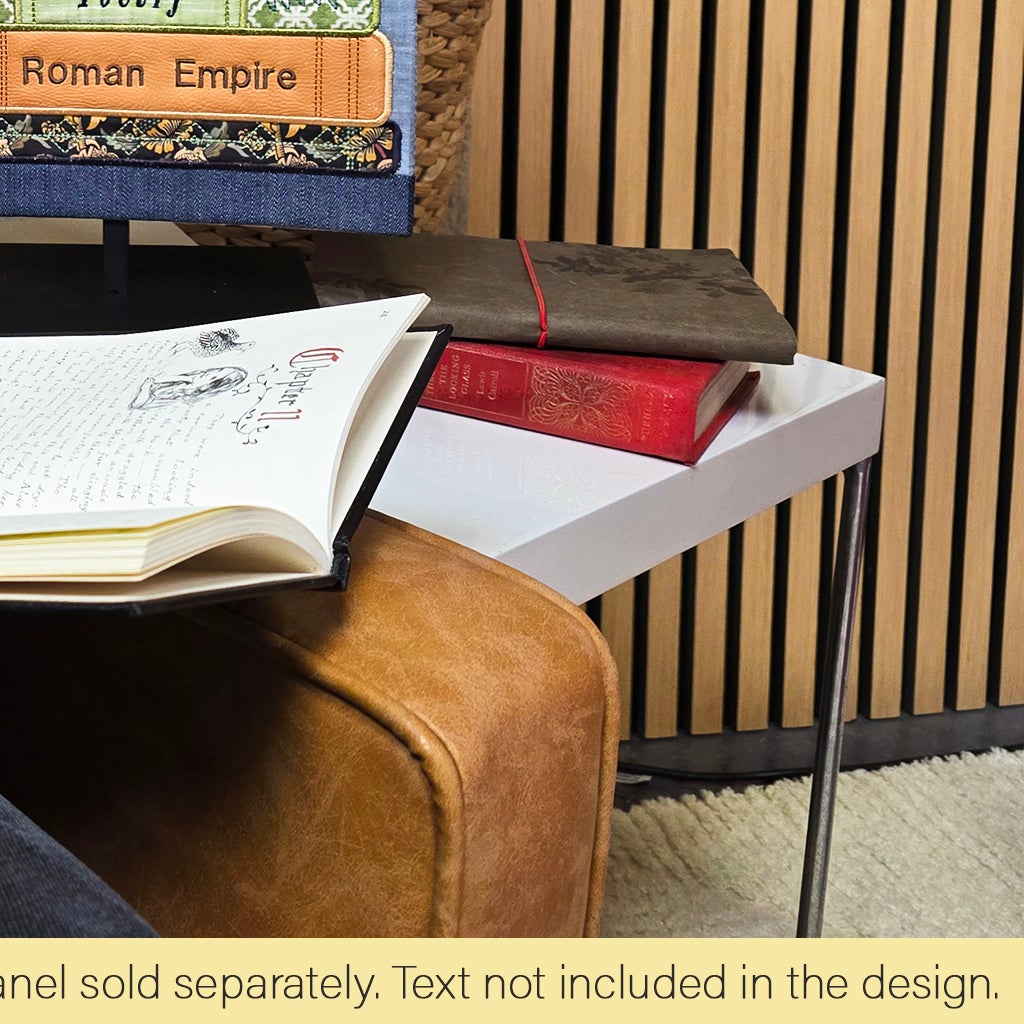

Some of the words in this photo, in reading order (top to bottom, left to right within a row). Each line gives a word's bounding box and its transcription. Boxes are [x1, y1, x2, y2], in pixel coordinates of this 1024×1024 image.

[22, 56, 145, 87] Roman
[175, 58, 297, 94] Empire
[274, 347, 344, 406] Chapter
[53, 475, 70, 494] The
[78, 472, 96, 511] clinging
[99, 460, 115, 503] animals
[116, 453, 134, 498] draggled
[147, 452, 165, 506] assembled
[163, 459, 185, 501] looking
[184, 468, 198, 506] indeed
